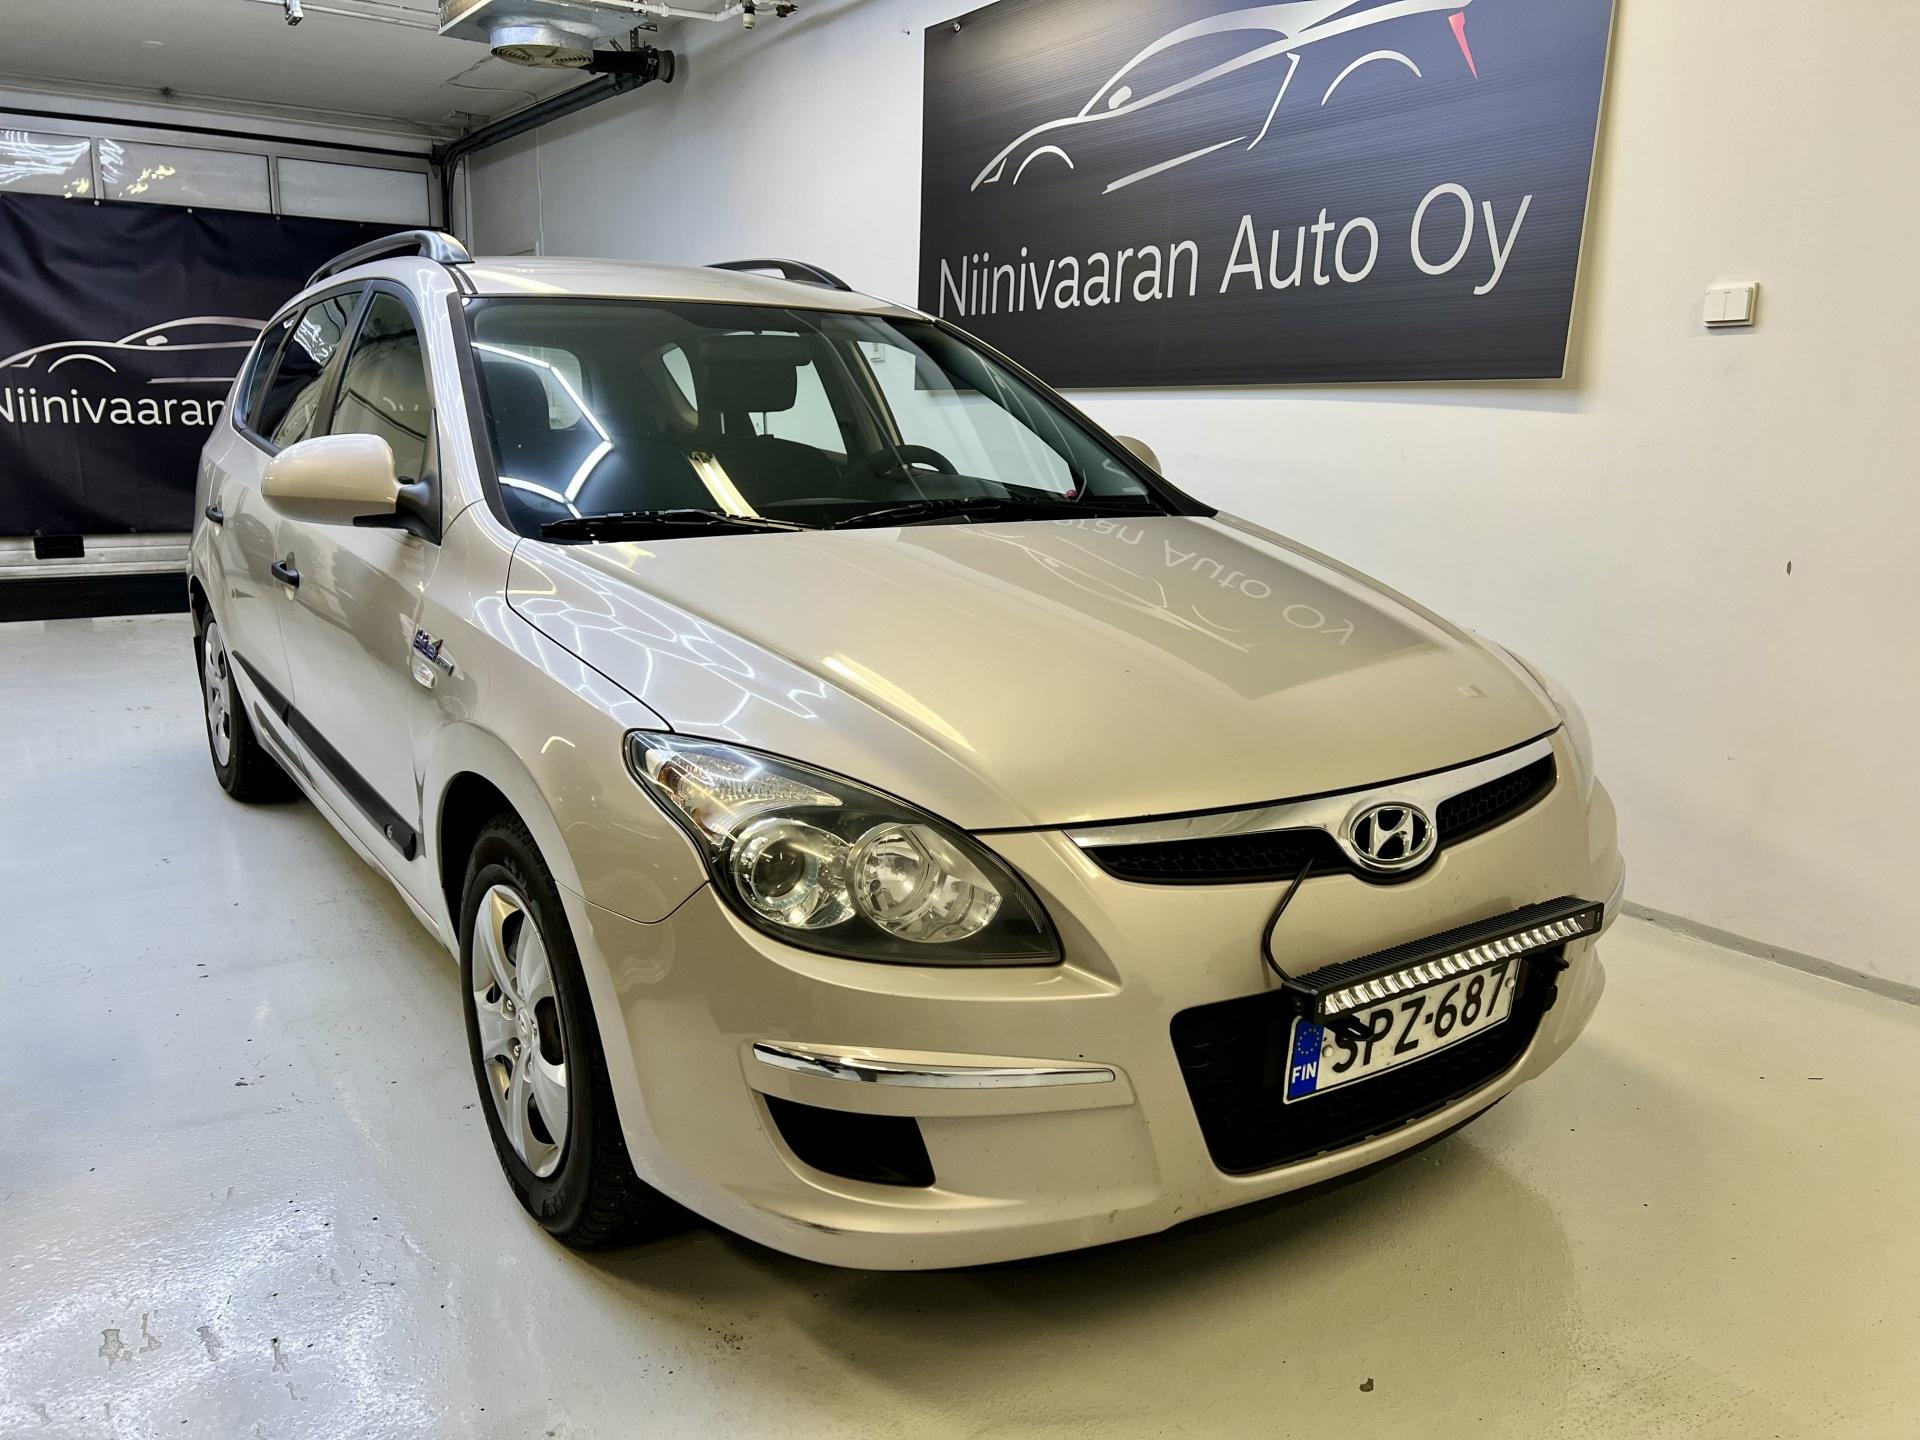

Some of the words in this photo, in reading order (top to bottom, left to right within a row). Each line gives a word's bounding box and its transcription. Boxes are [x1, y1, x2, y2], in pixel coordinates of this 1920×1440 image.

[939, 240, 1199, 318] Niinivaaran
[1219, 208, 1379, 294] Auto
[1410, 182, 1533, 295] Oy
[1291, 1061, 1317, 1084] FIN
[1331, 966, 1510, 1074] SPZ-687
